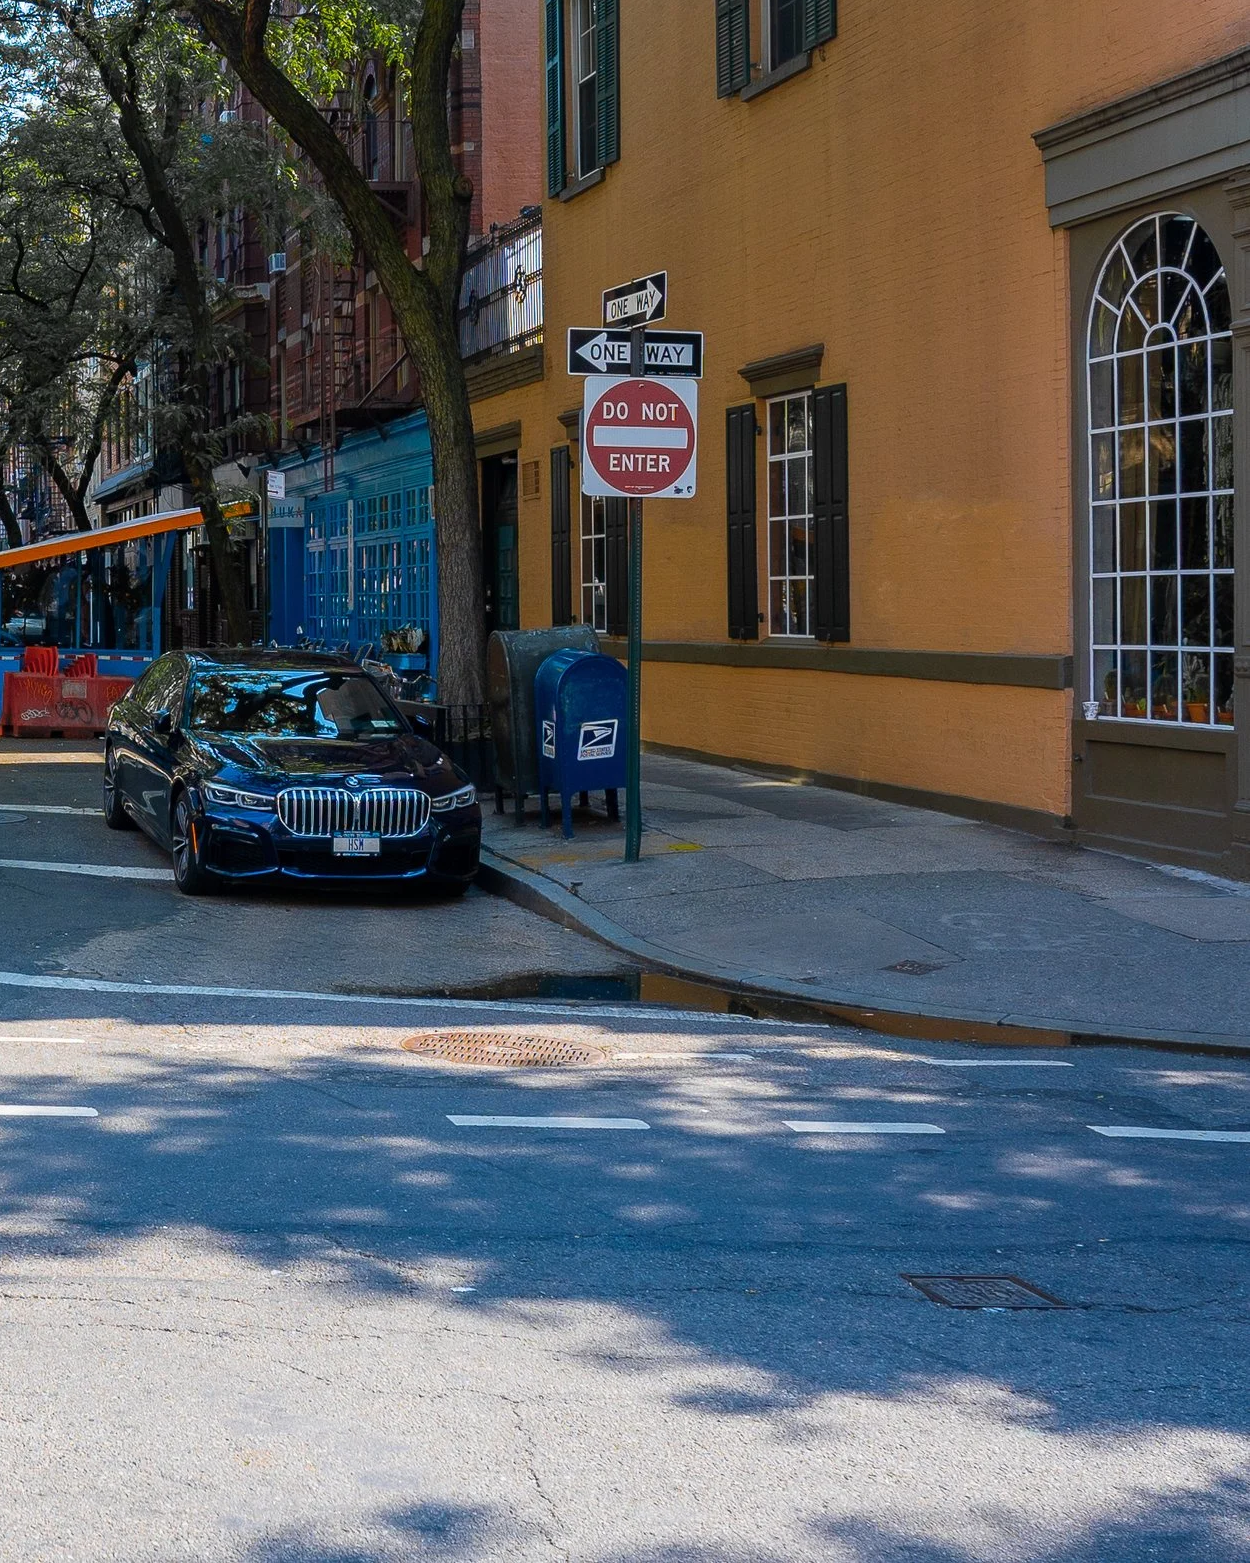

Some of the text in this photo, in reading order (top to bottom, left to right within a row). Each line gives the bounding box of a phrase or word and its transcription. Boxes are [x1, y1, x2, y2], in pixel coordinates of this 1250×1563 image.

[610, 289, 656, 319] ONE WAY
[590, 343, 685, 363] ONE WAY
[602, 401, 679, 421] DO NOT
[609, 453, 670, 473] ENTER
